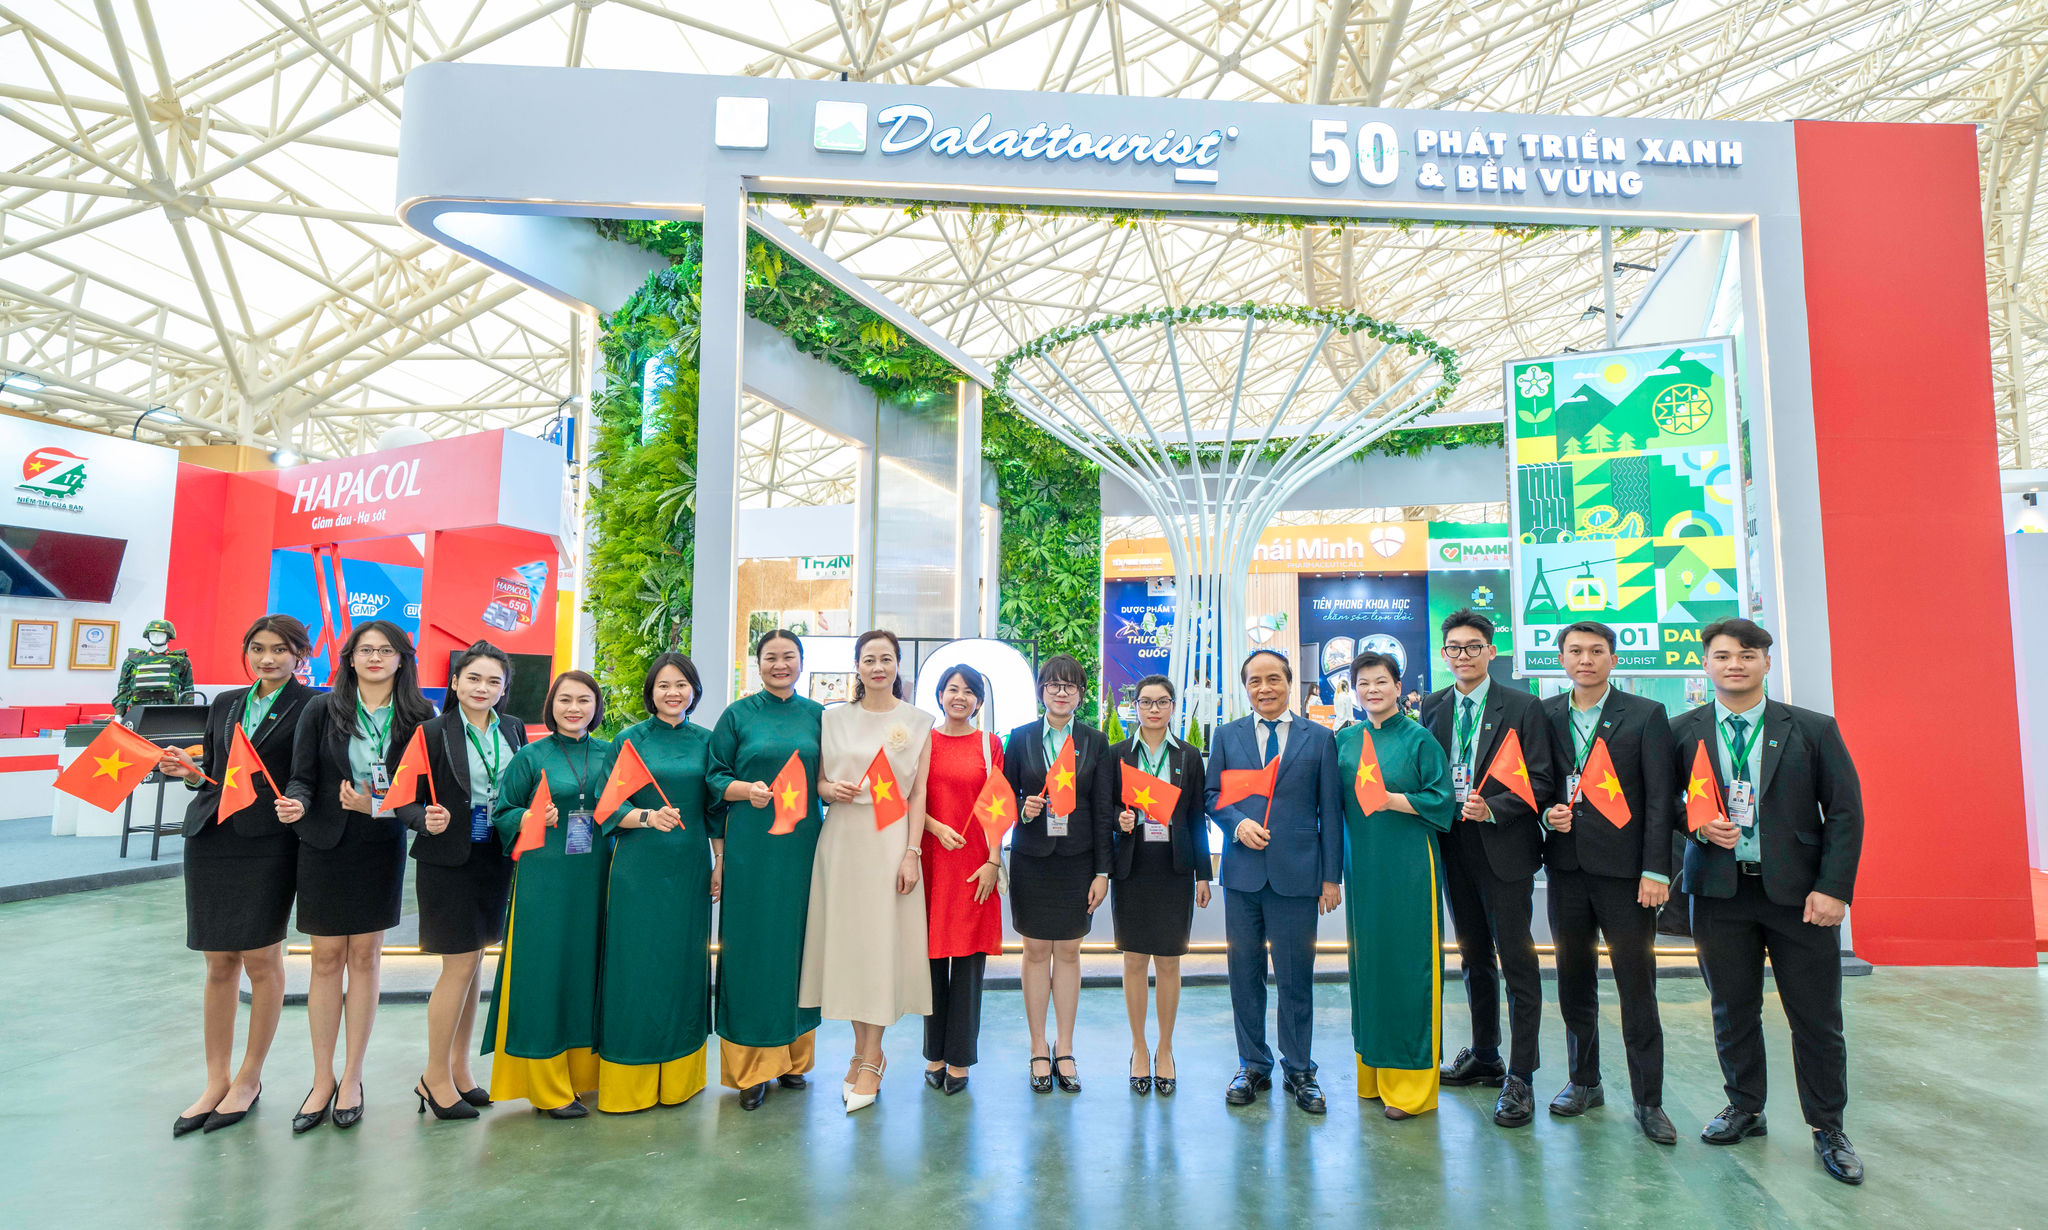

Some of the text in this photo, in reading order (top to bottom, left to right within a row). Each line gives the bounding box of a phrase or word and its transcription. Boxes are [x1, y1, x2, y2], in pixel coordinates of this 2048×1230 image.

[877, 103, 1223, 168] Dalattourist
[1309, 119, 1400, 188] 50
[1415, 126, 1508, 159] PHÁT
[1518, 128, 1626, 164] TRIỂN
[1637, 137, 1744, 168] XANH
[1416, 158, 1644, 198] & BỀN VỮNG
[63, 473, 82, 485] 17
[291, 458, 422, 514] HAPACOL
[335, 513, 352, 528] đau
[1253, 537, 1364, 561] hái Minh
[496, 581, 528, 597] HAPACOL
[347, 592, 384, 605] JAPAN
[1313, 596, 1332, 609] TIÊN
[1334, 599, 1363, 609] PHONG
[1365, 599, 1389, 609] KHOA
[352, 603, 376, 615] GMP
[407, 606, 418, 615] EU
[508, 599, 527, 613] 650
[1121, 606, 1145, 614] DƯỢC
[1147, 604, 1170, 613] PHẨM
[1138, 646, 1168, 658] QUỐC
[1528, 656, 1558, 665] MADE
